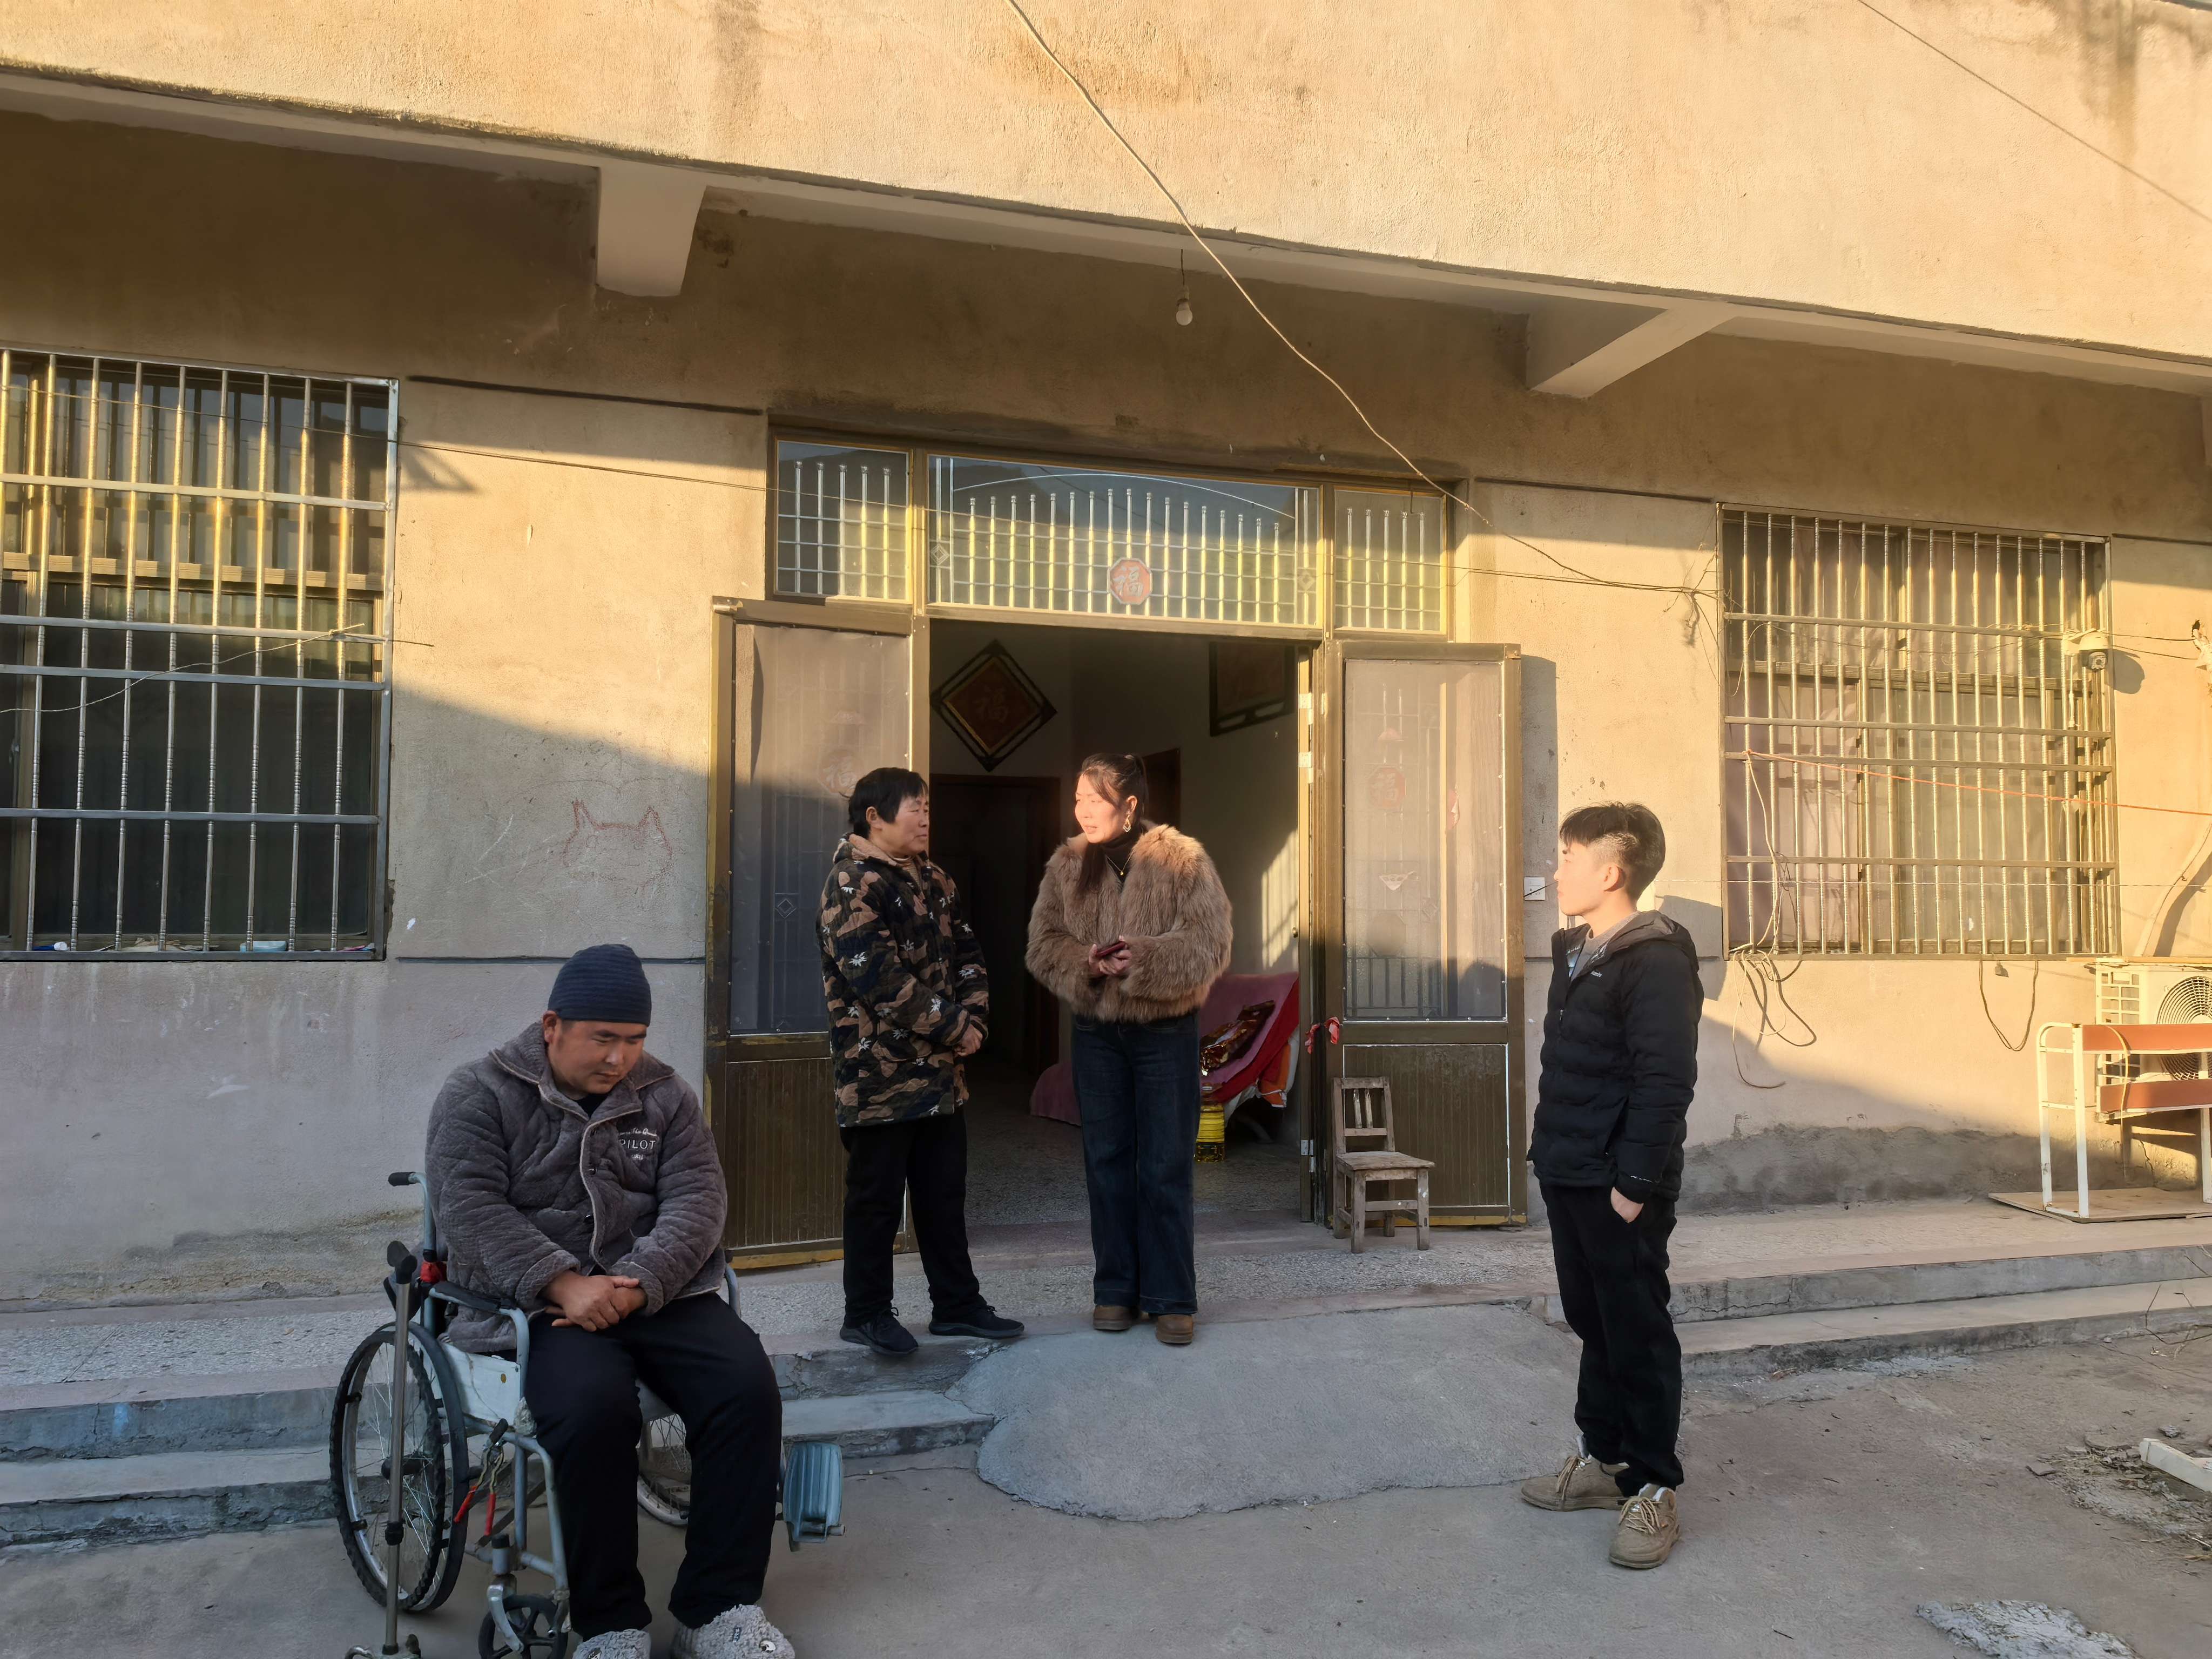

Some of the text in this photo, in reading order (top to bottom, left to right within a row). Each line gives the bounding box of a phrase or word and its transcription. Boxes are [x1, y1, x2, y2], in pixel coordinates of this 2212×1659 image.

[1113, 565, 1143, 597] 福
[971, 684, 1009, 724] 福
[824, 757, 857, 790] 福
[1372, 772, 1398, 802] 福
[619, 1139, 656, 1149] PILOT
